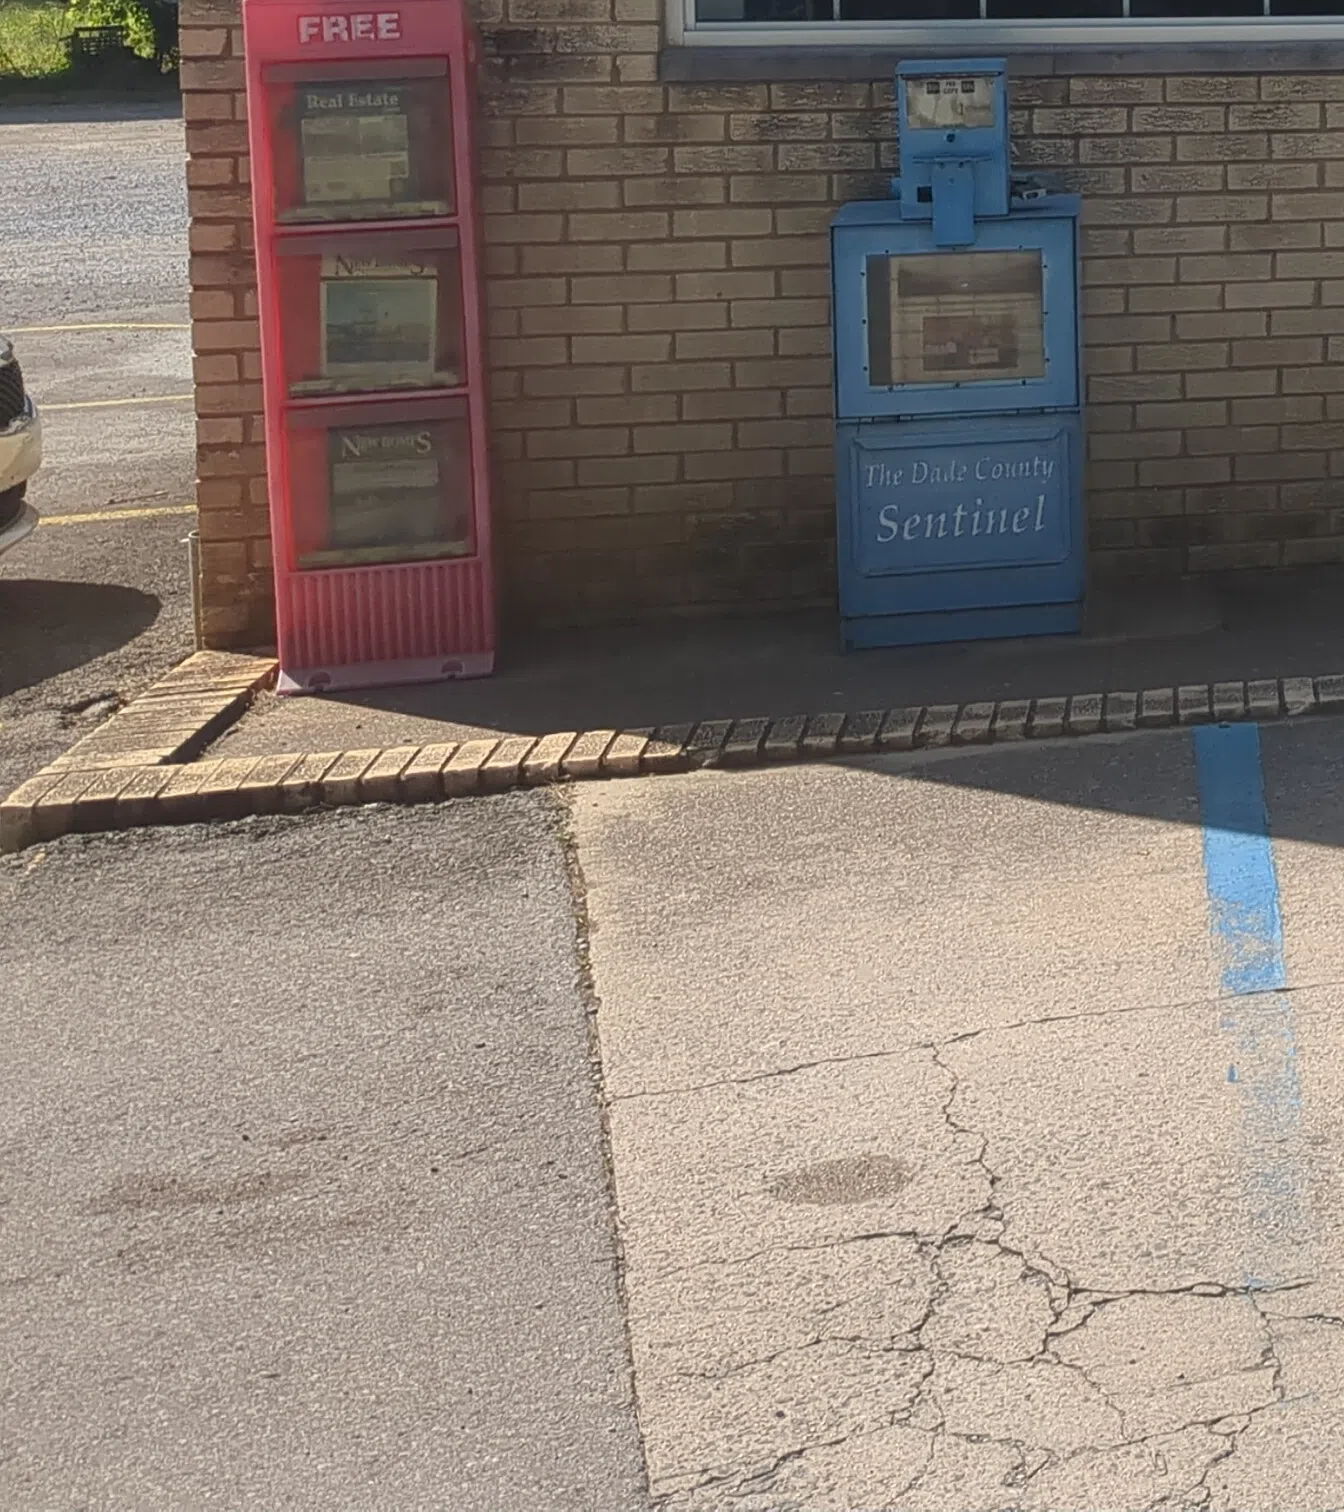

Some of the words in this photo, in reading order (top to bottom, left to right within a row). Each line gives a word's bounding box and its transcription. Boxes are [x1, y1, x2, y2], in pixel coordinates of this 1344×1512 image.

[298, 13, 402, 44] FREE
[305, 93, 344, 109] Real
[348, 92, 399, 107] Estate
[864, 462, 904, 488] The
[911, 459, 968, 484] Dade
[975, 455, 1056, 484] County
[875, 494, 1048, 543] Sentinel
